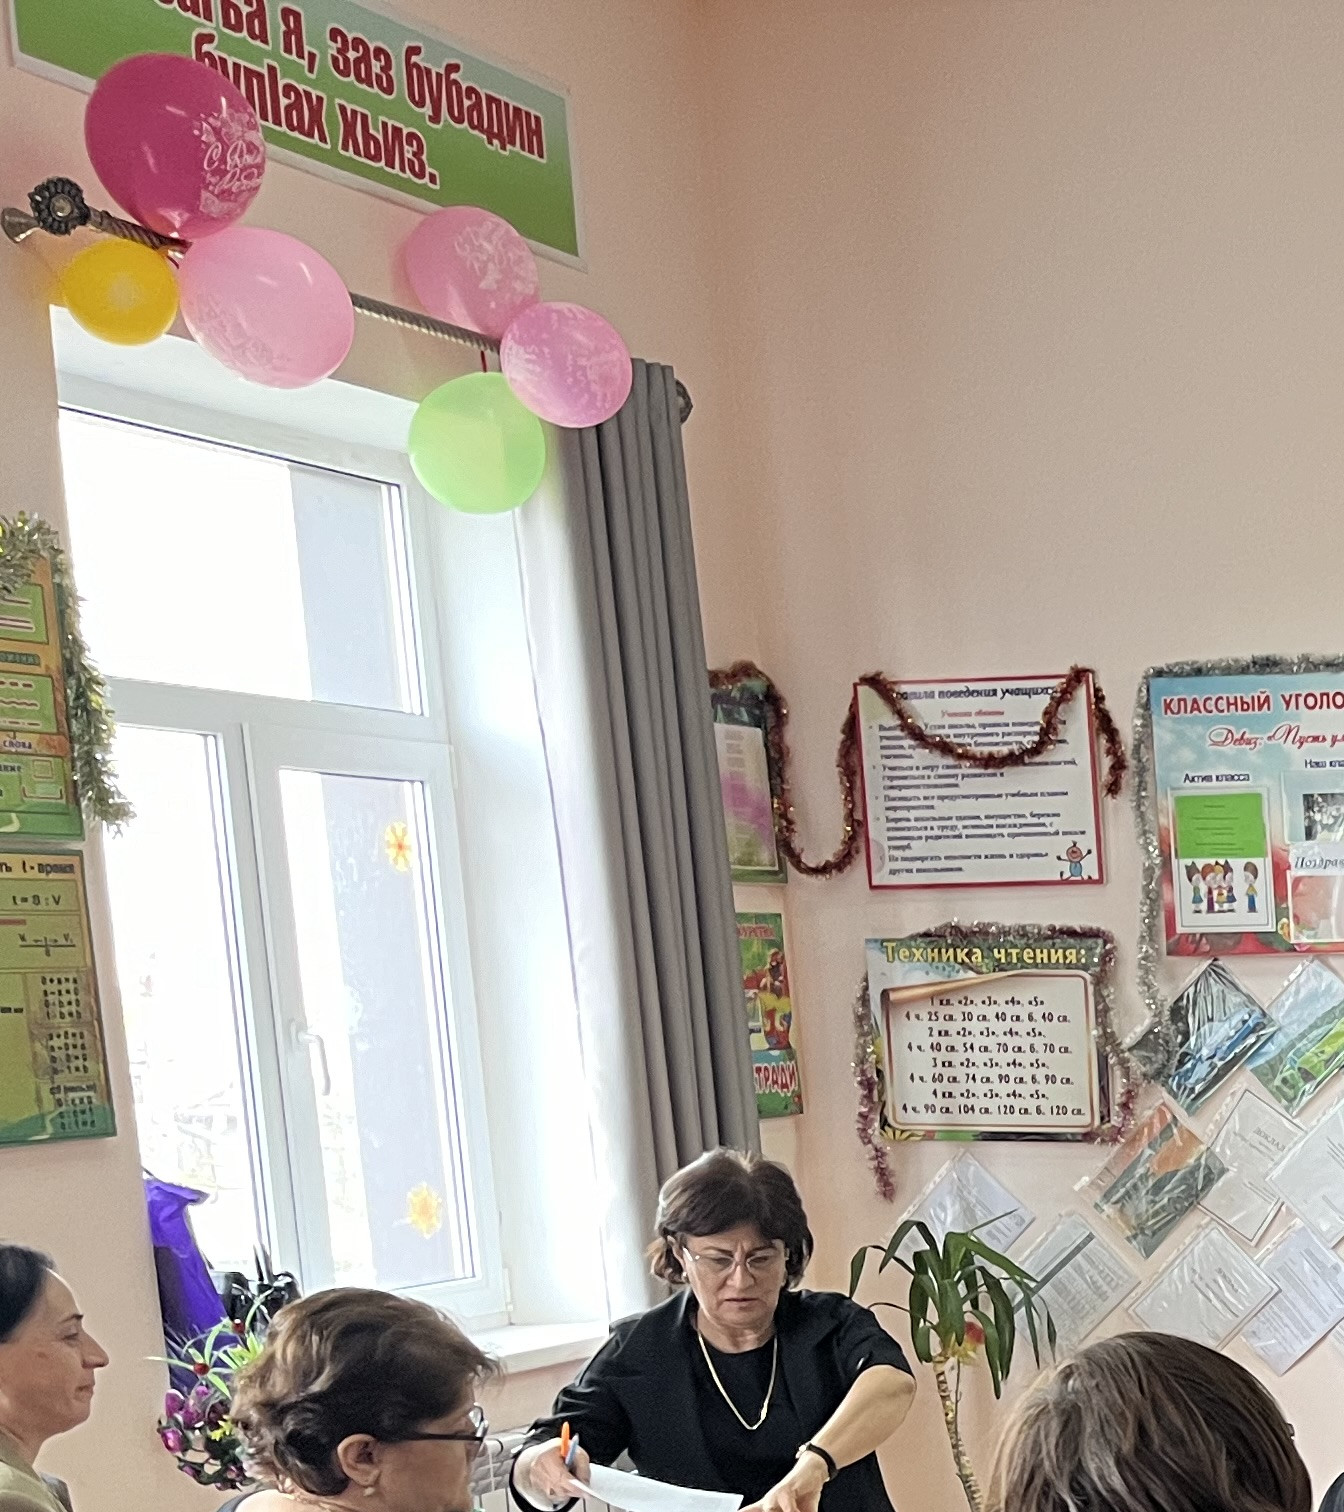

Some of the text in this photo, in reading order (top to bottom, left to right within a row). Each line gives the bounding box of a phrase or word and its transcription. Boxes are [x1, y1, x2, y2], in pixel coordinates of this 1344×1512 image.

[280, 6, 318, 75] я,
[329, 26, 395, 97] заз
[404, 45, 545, 160] бубадин
[337, 102, 439, 187] хьиз.
[937, 685, 998, 700] поведения
[1163, 691, 1271, 716] КЛАССНЫЙ
[1304, 758, 1327, 768] Наш
[1183, 772, 1250, 784] Актив класса
[883, 941, 1087, 964] Техника чтения:
[905, 1012, 1053, 1022] 4 25 30 40 40
[907, 1043, 1055, 1054] 4 40 54 70 70
[755, 1065, 797, 1091] ТРАДИ
[909, 1074, 1057, 1085] 4 60 74 90 90
[902, 1104, 1067, 1116] 4 90 104 120 120
